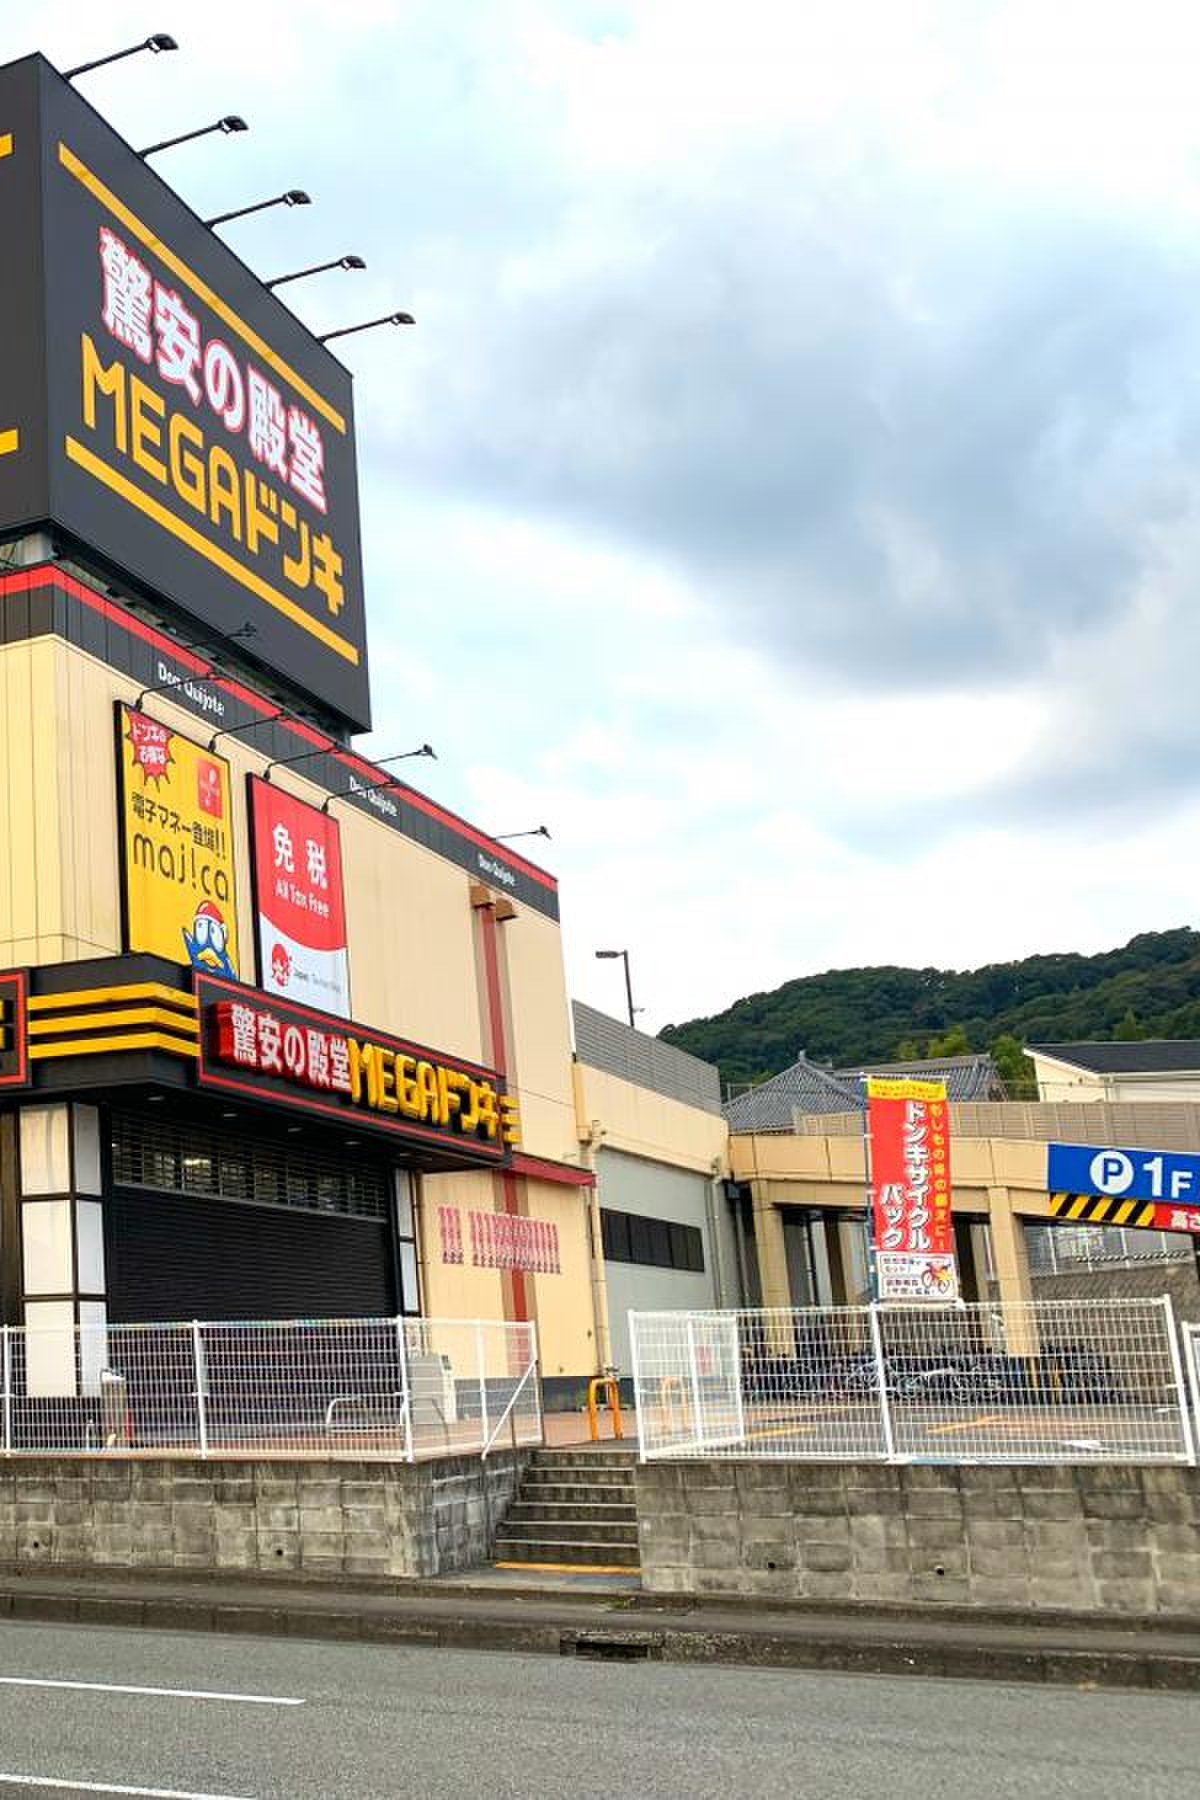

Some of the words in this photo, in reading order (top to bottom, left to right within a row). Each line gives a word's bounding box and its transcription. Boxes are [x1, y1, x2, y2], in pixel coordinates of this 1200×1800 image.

[100, 226, 327, 514] 驚安の殿堂
[81, 333, 344, 617] MEGAドンキ
[231, 1002, 351, 1090] 驚安の殿堂
[348, 1037, 499, 1138] MEGAドンキ
[880, 1183, 905, 1249] パック
[903, 1101, 931, 1250] ドンキサイクル
[1143, 1157, 1193, 1199] 1F
